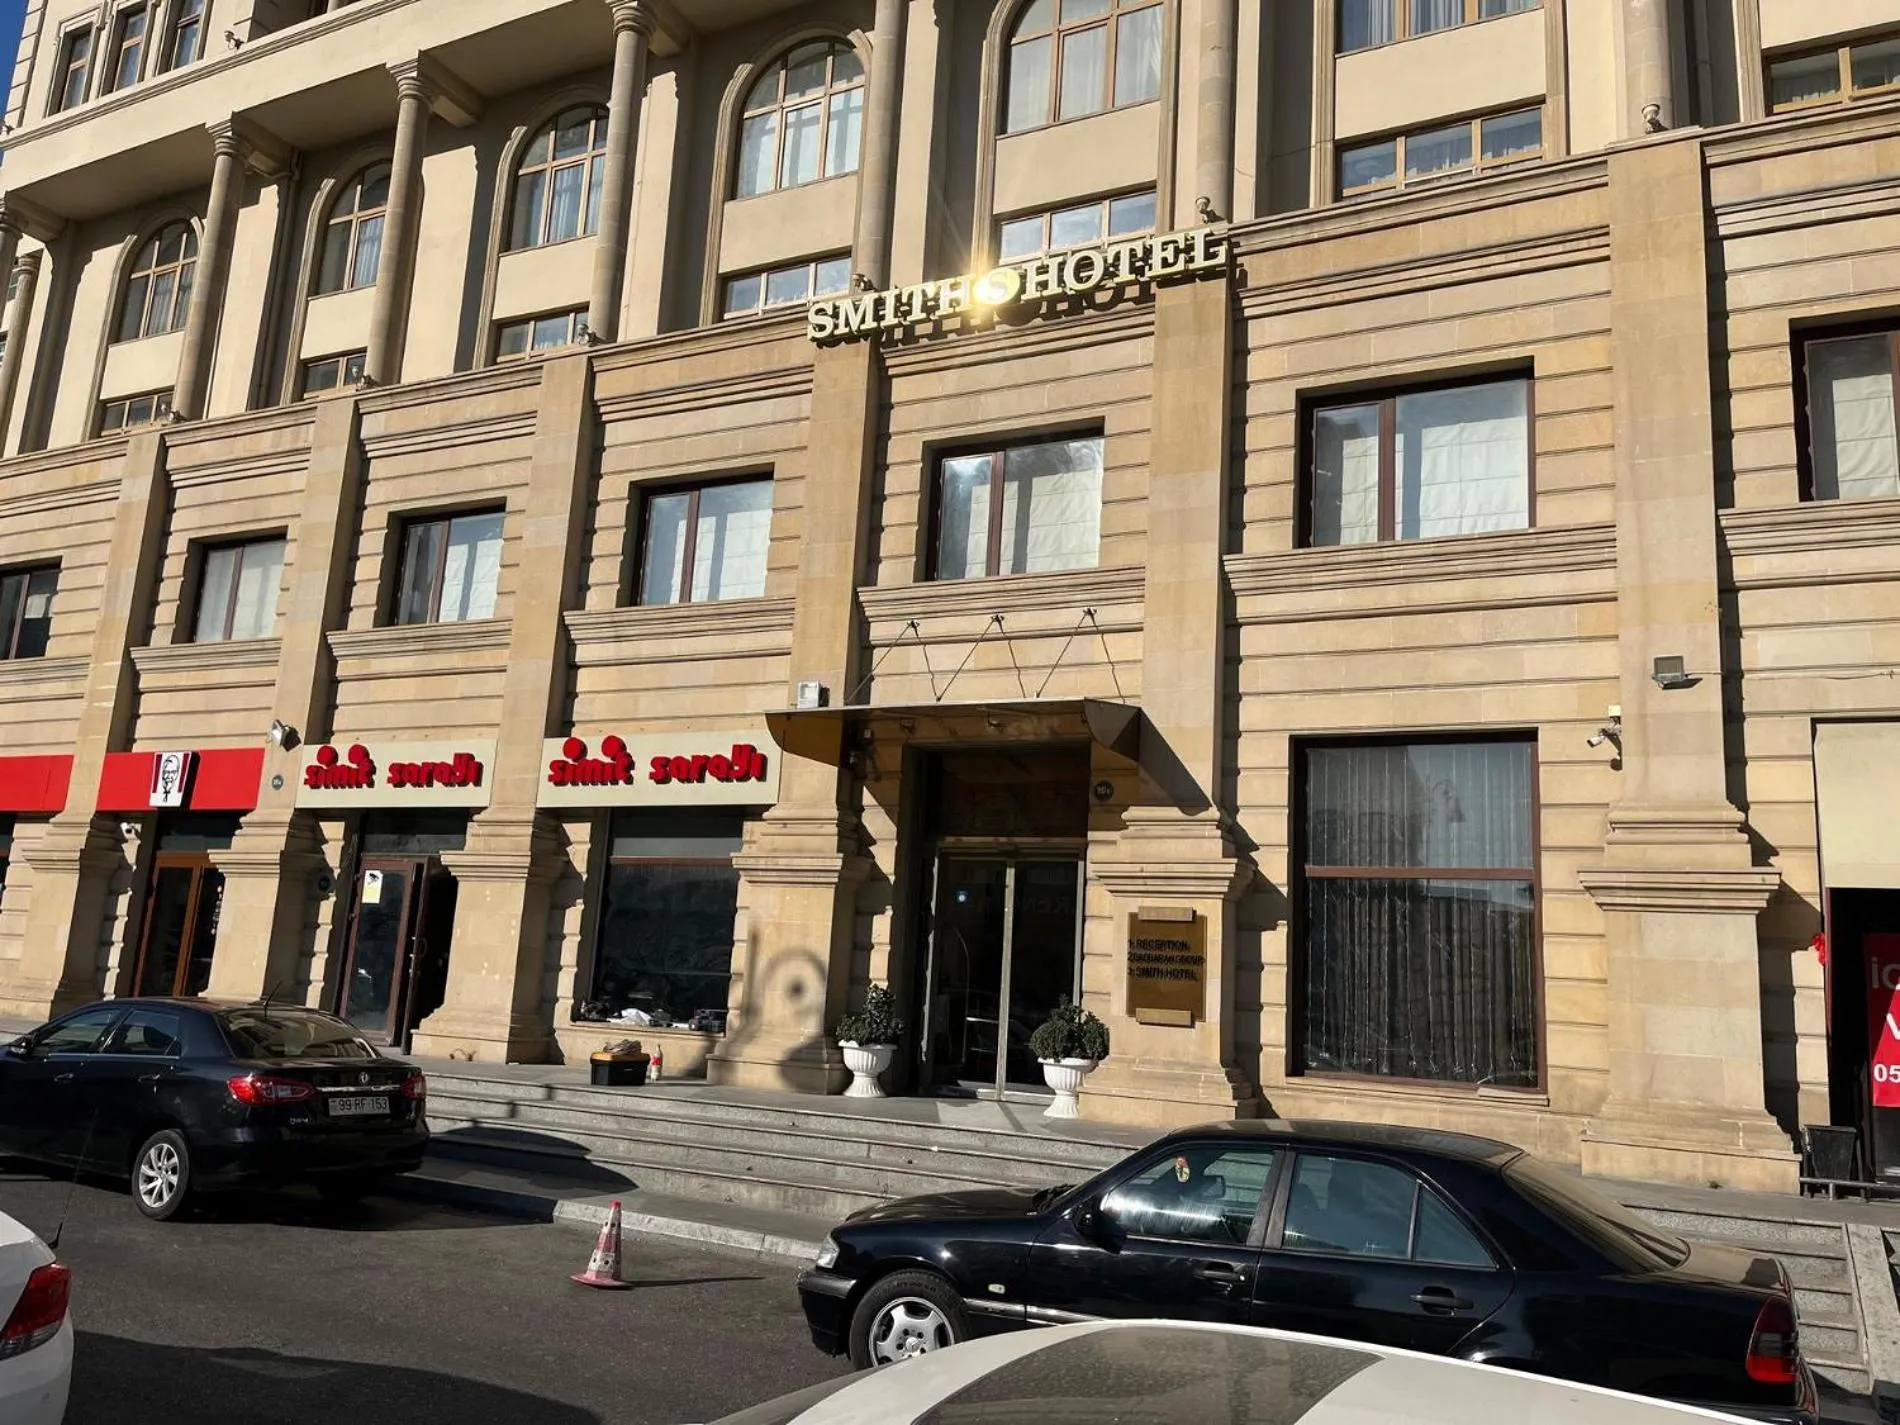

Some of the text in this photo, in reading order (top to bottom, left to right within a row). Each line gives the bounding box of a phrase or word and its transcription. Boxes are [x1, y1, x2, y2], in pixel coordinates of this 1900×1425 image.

[807, 273, 973, 340] SMITH
[1021, 226, 1227, 300] HOTEL
[304, 743, 377, 789] simit
[548, 735, 635, 786] simit
